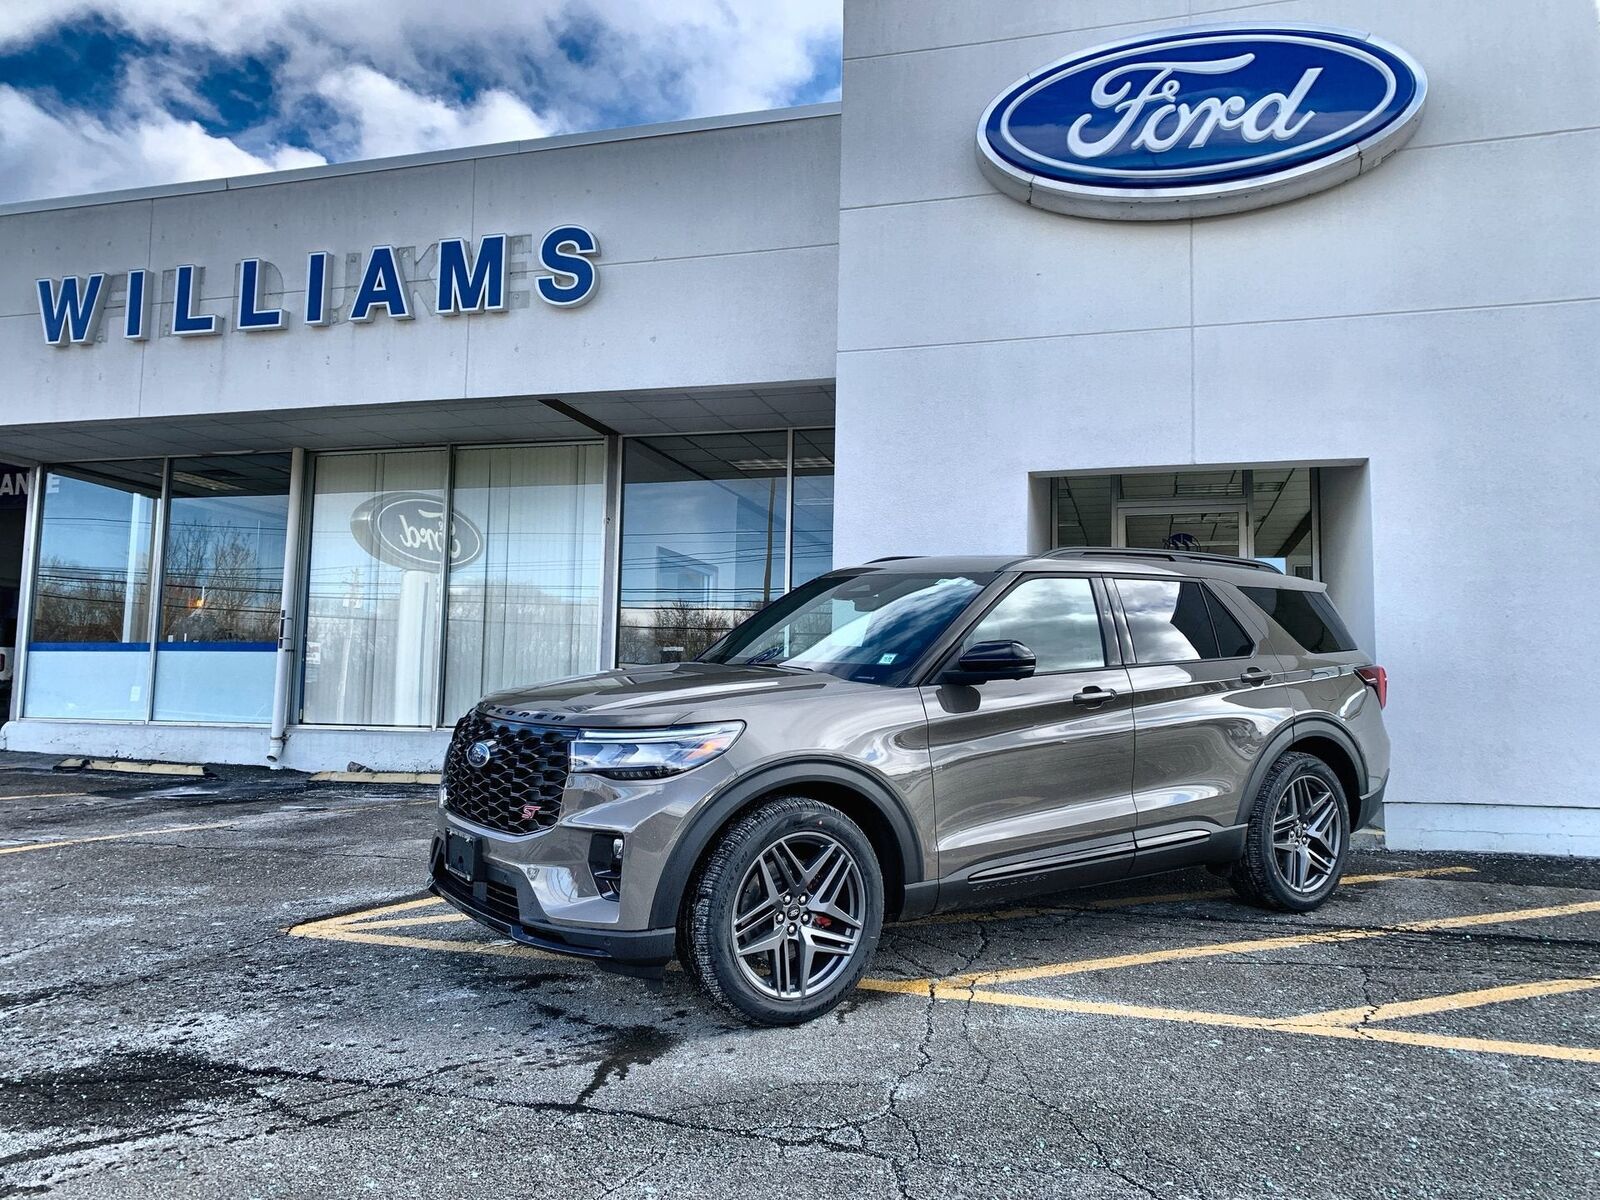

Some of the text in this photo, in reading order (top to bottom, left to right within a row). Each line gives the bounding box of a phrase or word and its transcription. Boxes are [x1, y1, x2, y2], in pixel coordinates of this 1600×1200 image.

[1066, 52, 1324, 159] Ford
[35, 223, 600, 347] WILLIAMS
[0, 472, 60, 496] ANE
[521, 805, 542, 819] ST
